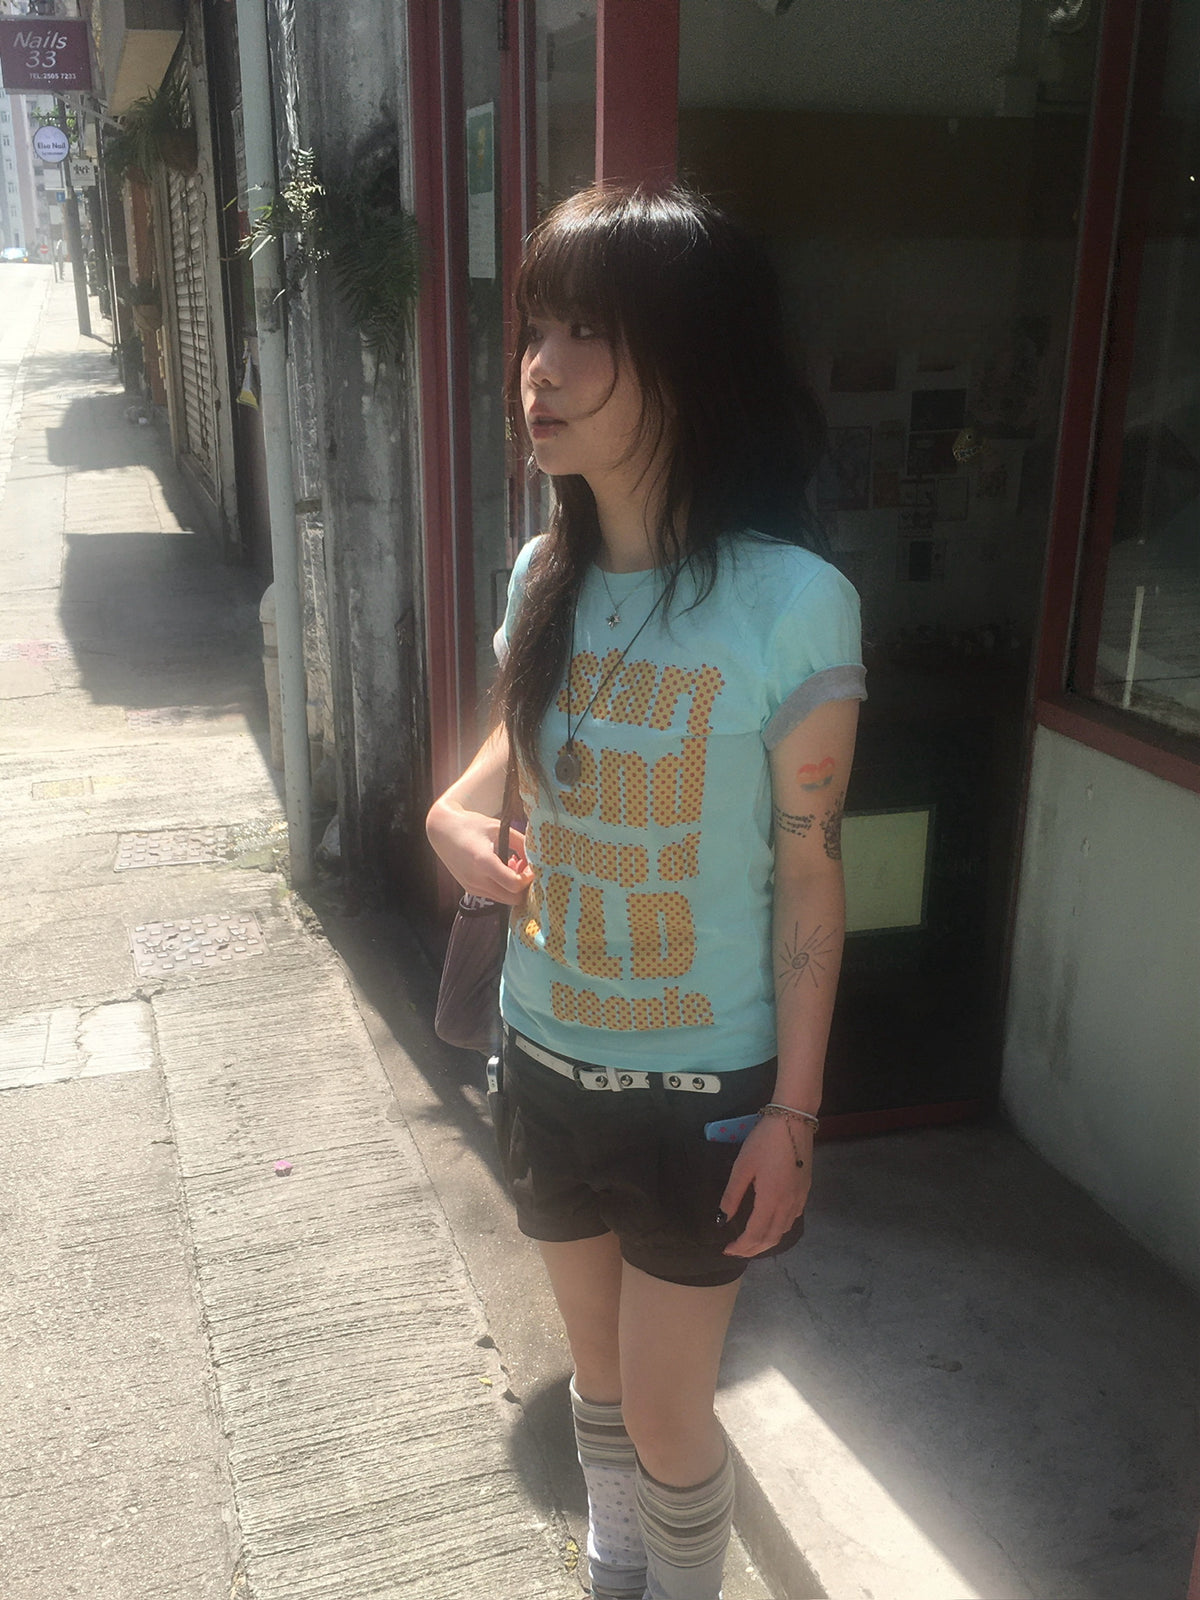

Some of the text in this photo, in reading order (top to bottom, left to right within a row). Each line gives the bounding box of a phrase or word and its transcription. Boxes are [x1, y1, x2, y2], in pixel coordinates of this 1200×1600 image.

[13, 31, 68, 49] Nails
[26, 50, 57, 68] 33
[540, 821, 649, 888] group
[657, 831, 701, 883] of
